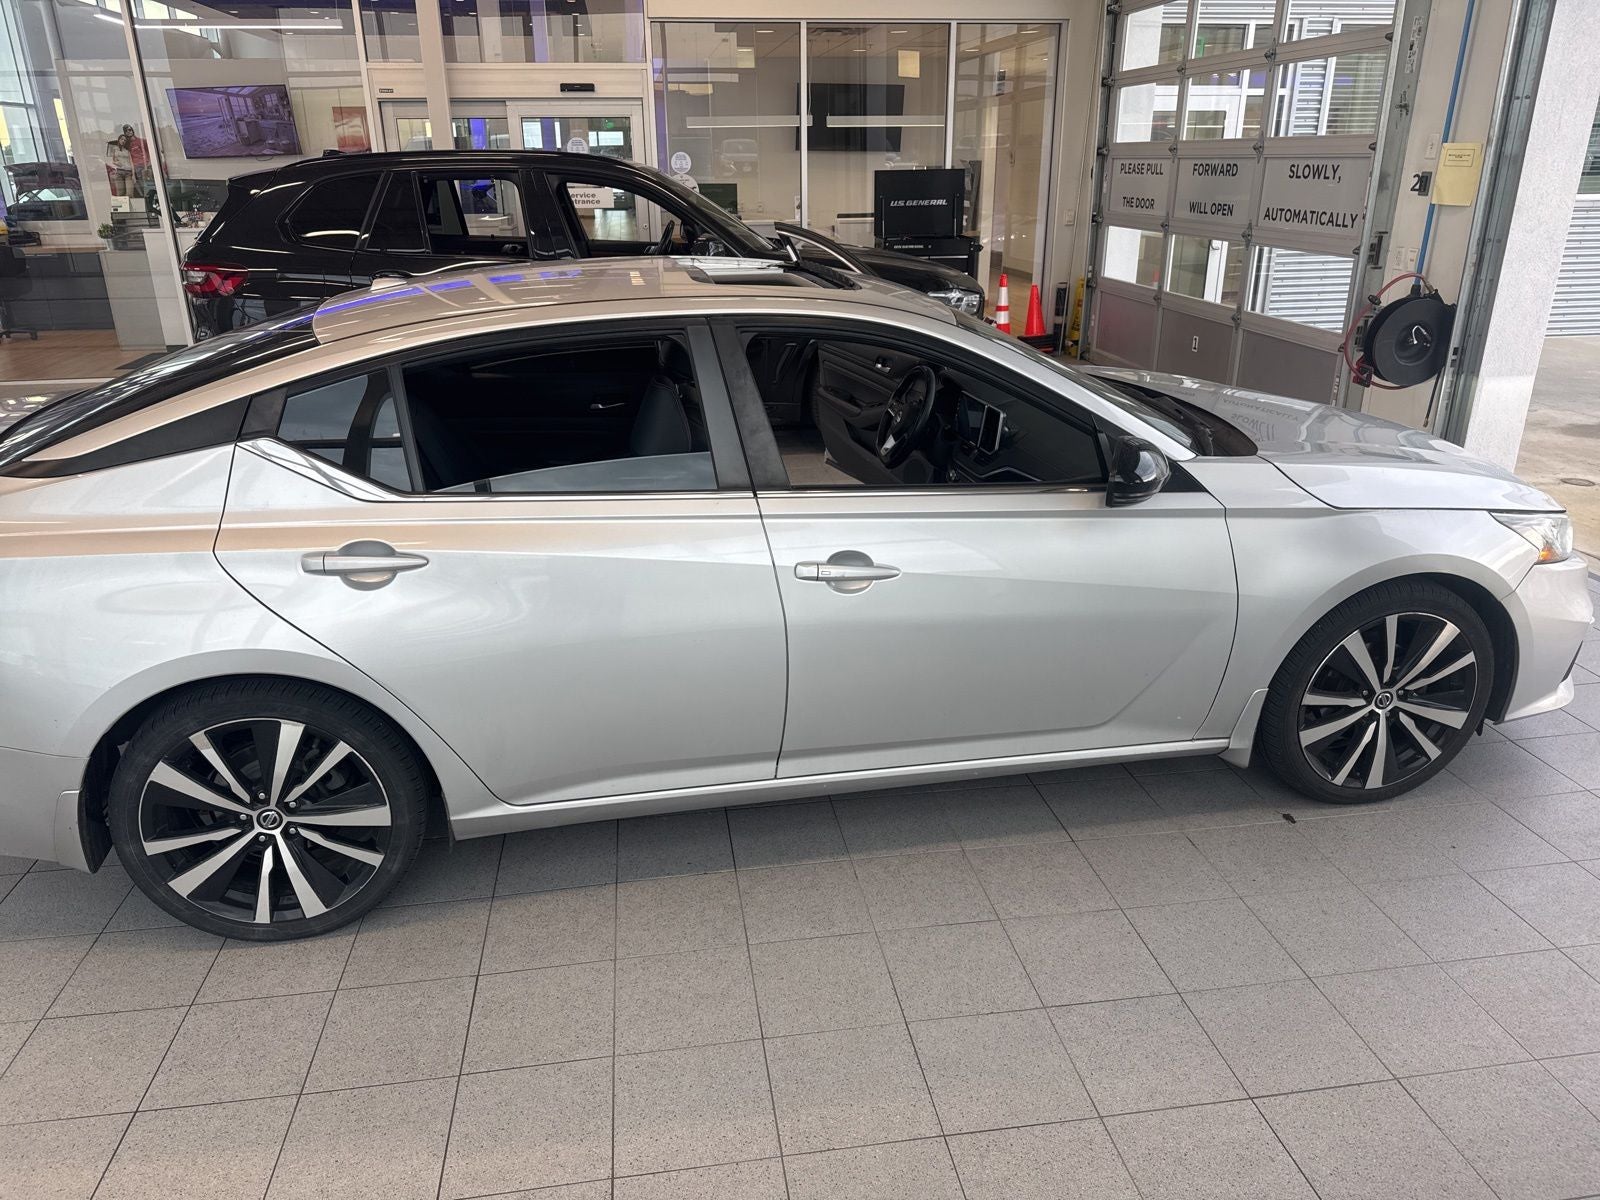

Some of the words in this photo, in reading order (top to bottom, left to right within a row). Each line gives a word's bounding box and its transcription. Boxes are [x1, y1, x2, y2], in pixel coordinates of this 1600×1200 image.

[1120, 162, 1145, 175] PLEASE
[1146, 163, 1164, 176] PULL
[1192, 163, 1238, 177] FORWARD
[1288, 163, 1341, 183] SLOWLY,
[1410, 173, 1422, 191] 2
[1122, 196, 1134, 208] THE
[1135, 198, 1155, 210] DOOR
[1189, 201, 1208, 215] WILL
[1210, 202, 1234, 217] OPEN
[1263, 206, 1359, 229] AUTOMATICALLY
